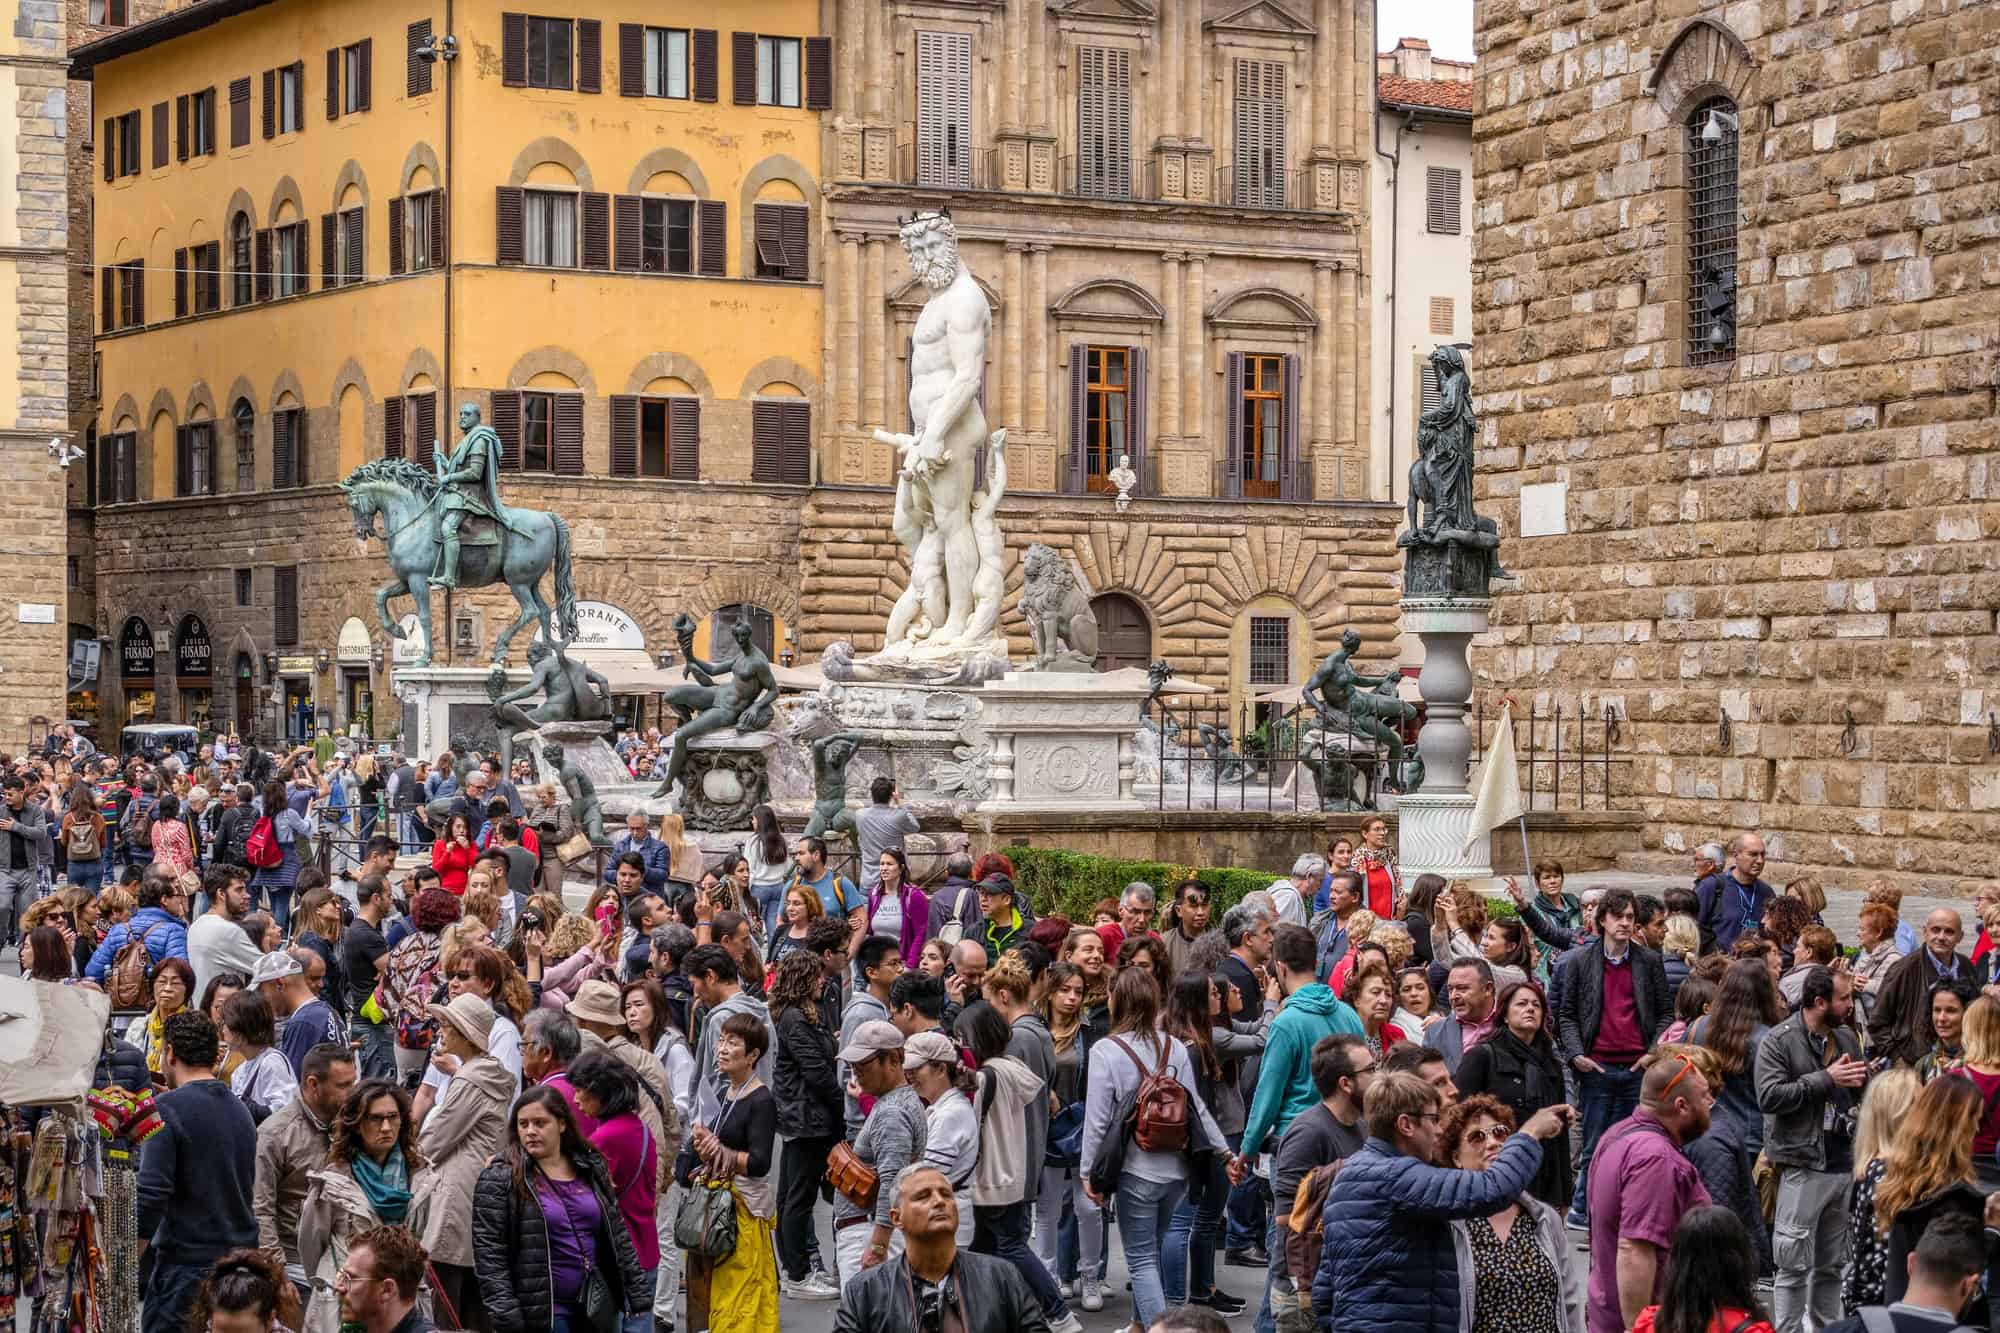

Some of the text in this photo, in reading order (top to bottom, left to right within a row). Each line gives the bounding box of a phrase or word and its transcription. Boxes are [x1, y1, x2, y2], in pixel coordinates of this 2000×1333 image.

[550, 608, 629, 633] RORANTE
[124, 646, 153, 659] FUSARO
[180, 645, 210, 658] FUSARO
[338, 645, 370, 655] RISTORANTE
